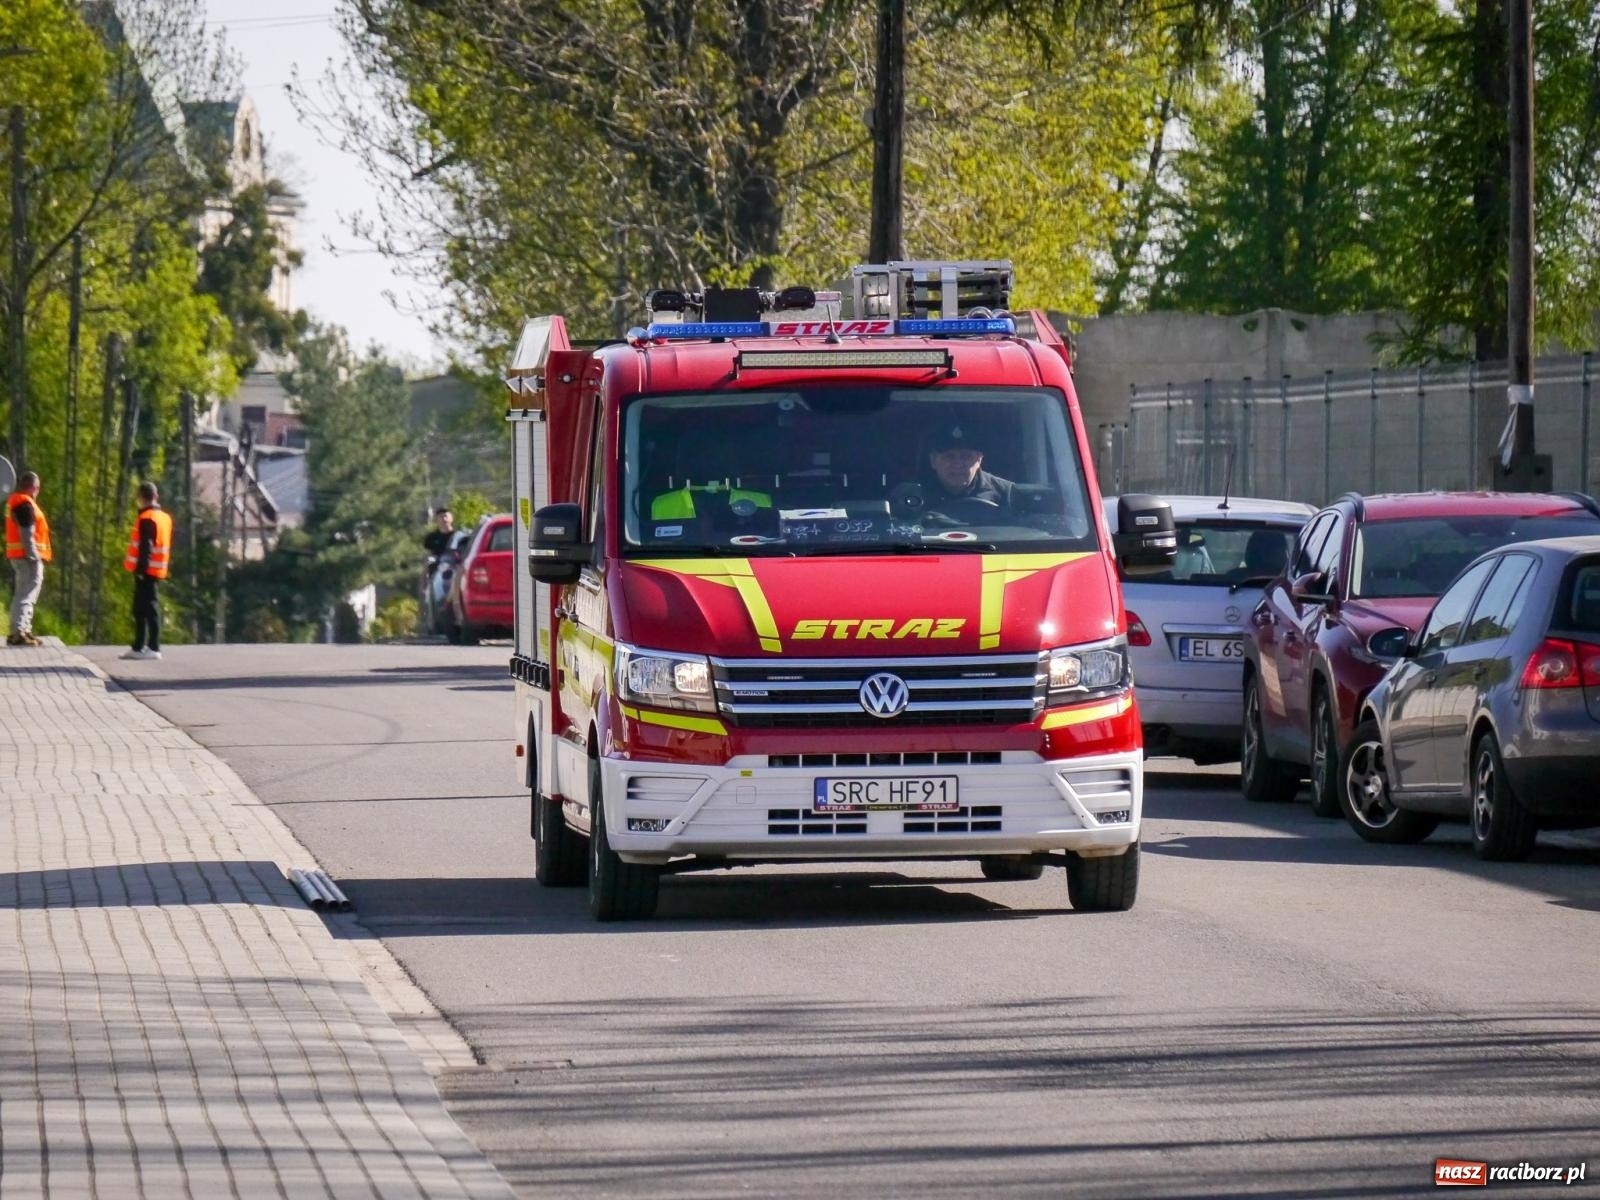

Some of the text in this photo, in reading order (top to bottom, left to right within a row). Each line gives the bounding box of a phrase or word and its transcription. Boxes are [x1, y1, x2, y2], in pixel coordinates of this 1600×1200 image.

[1193, 640, 1215, 657] EL
[817, 795, 827, 803] PL
[833, 779, 947, 803] SRC HF91
